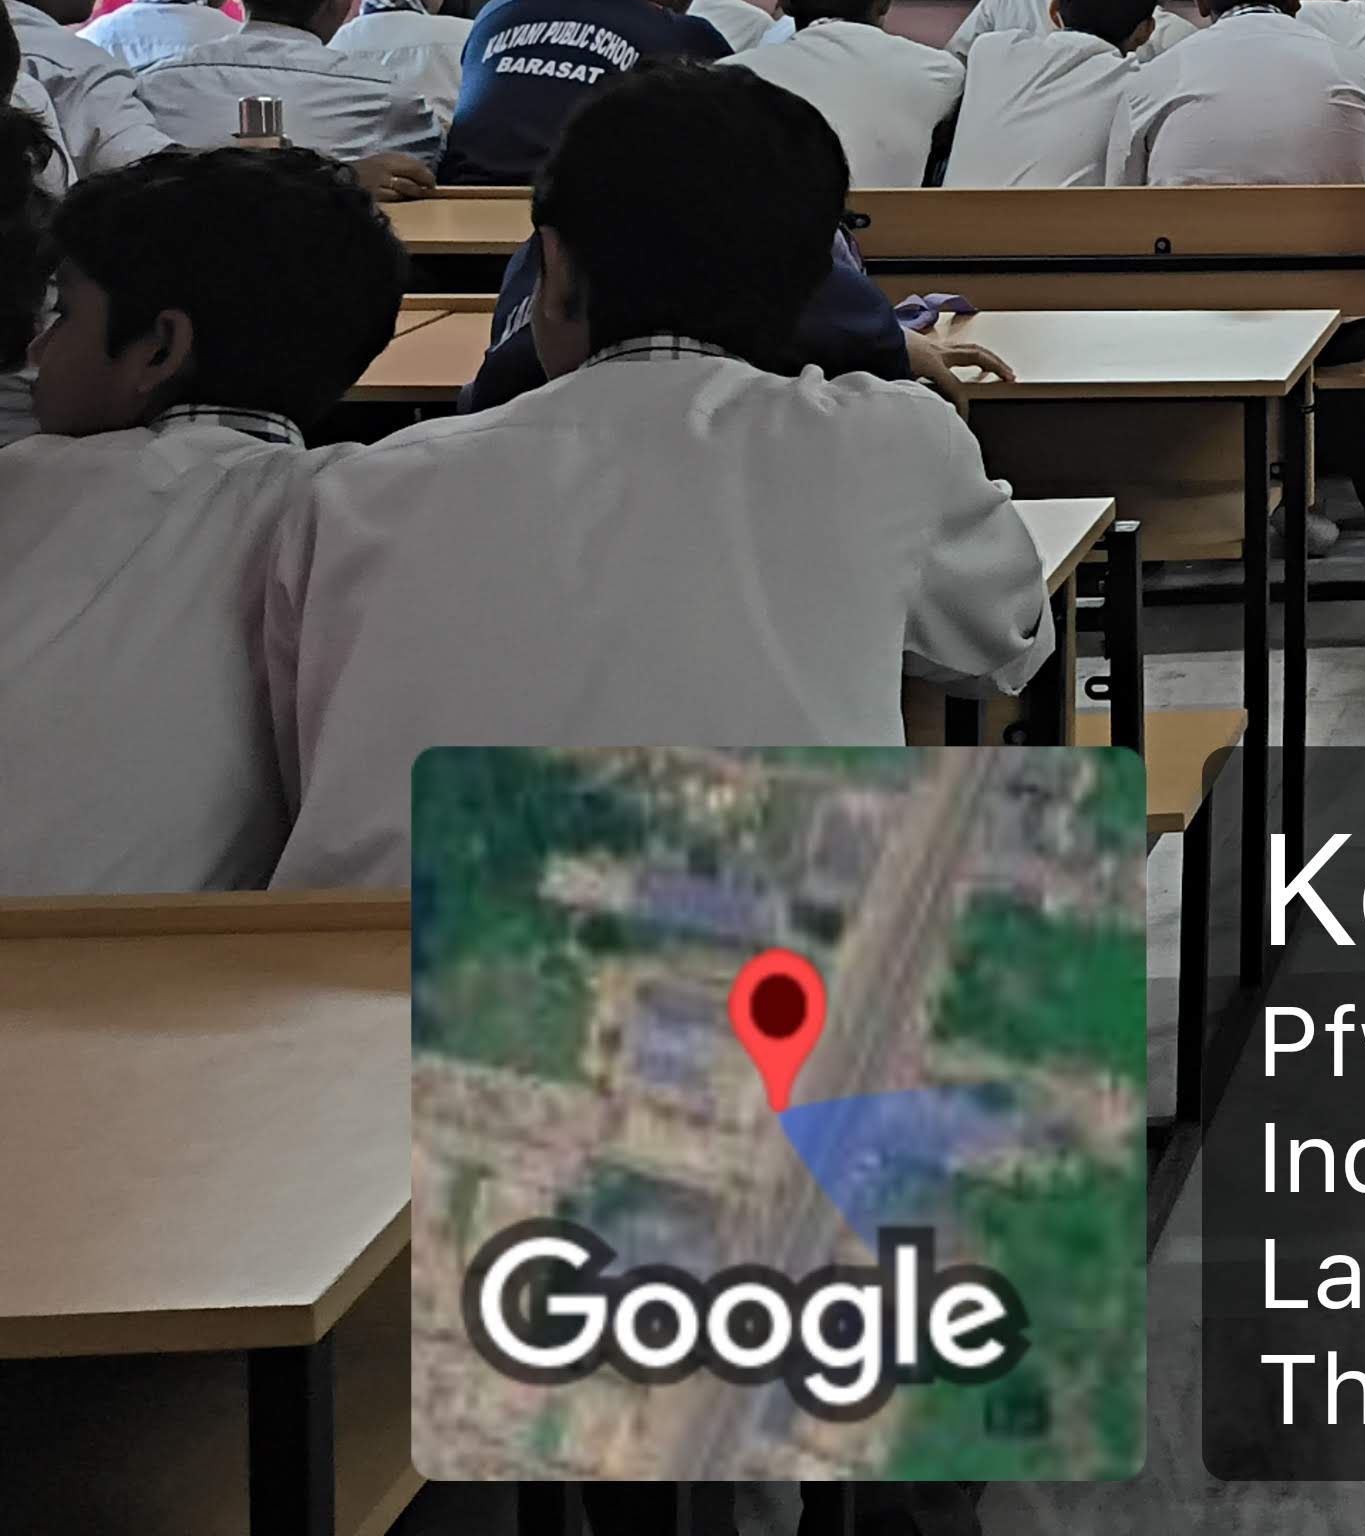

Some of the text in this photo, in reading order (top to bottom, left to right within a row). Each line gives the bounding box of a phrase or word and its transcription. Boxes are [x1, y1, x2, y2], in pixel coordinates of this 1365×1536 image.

[481, 21, 548, 63] KALYANI
[540, 20, 595, 50] PUBLIC
[496, 56, 605, 84] BARASAT
